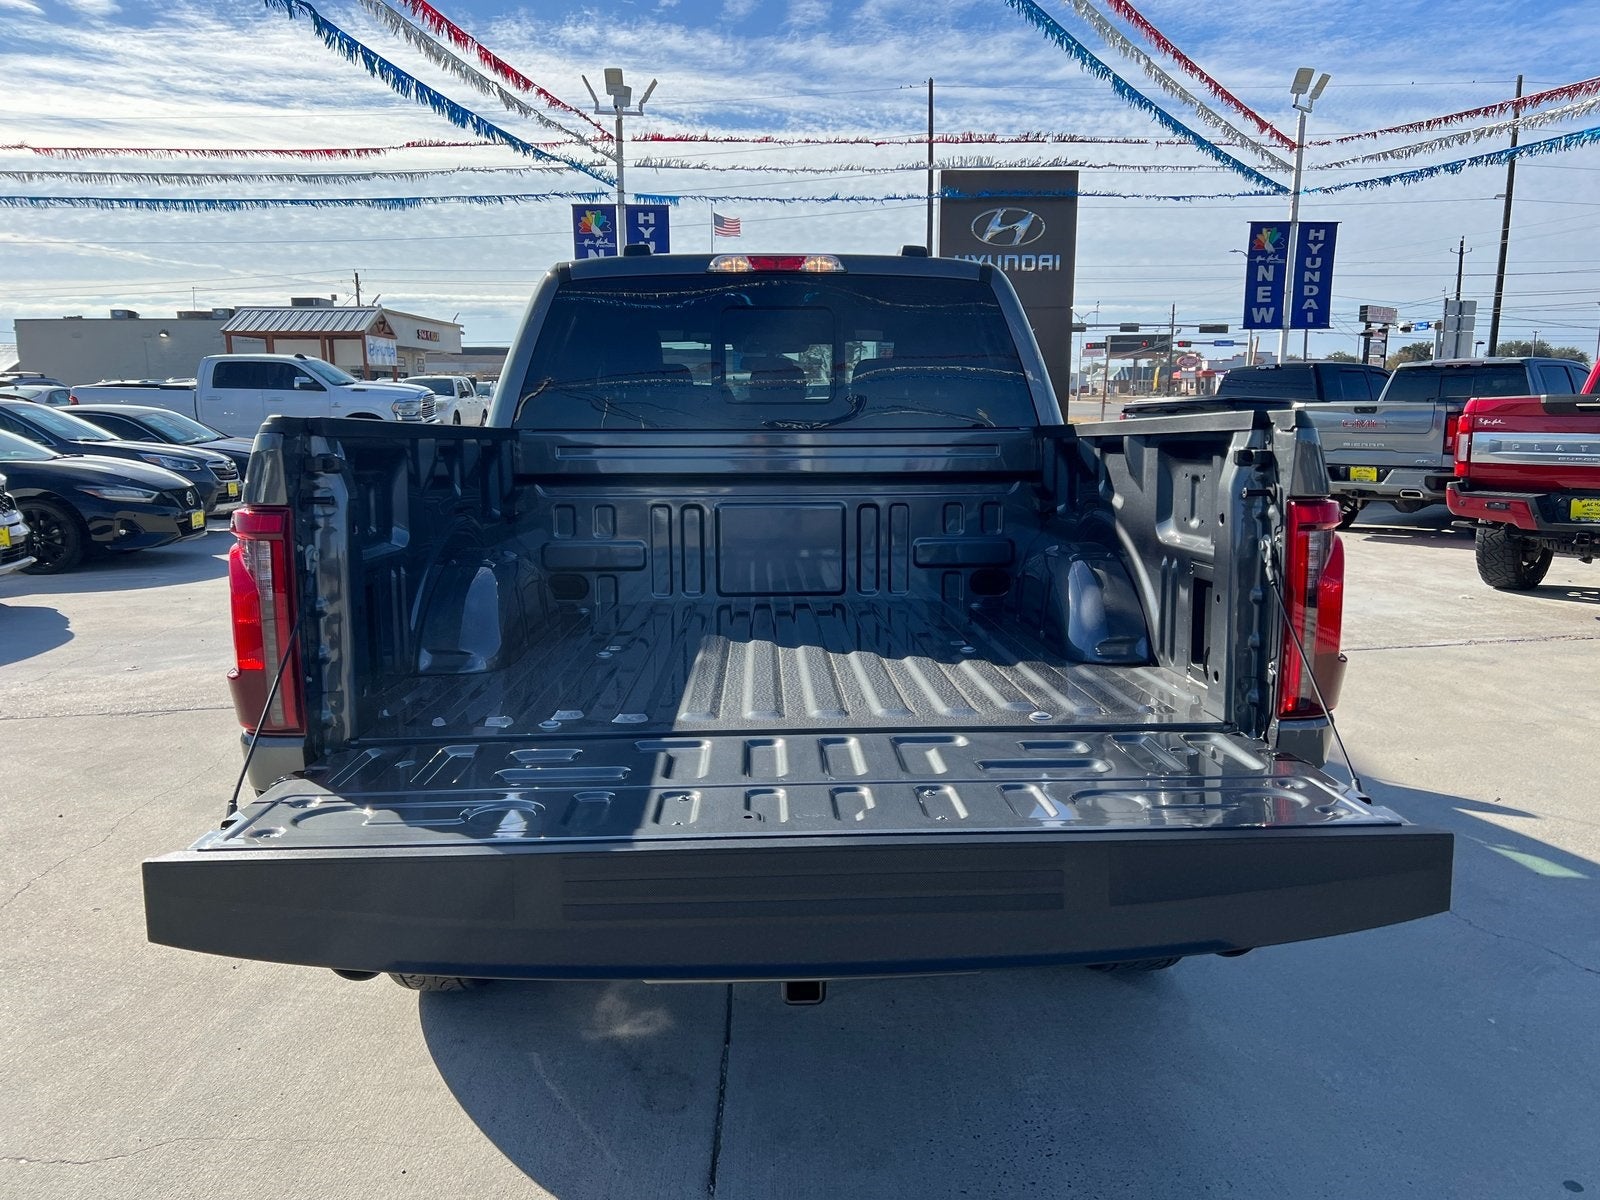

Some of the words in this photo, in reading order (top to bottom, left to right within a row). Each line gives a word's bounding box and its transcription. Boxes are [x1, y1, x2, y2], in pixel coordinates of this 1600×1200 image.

[1251, 265, 1275, 324] NEW
[1302, 229, 1326, 323] HYUNDAI
[1341, 418, 1386, 429] GMC
